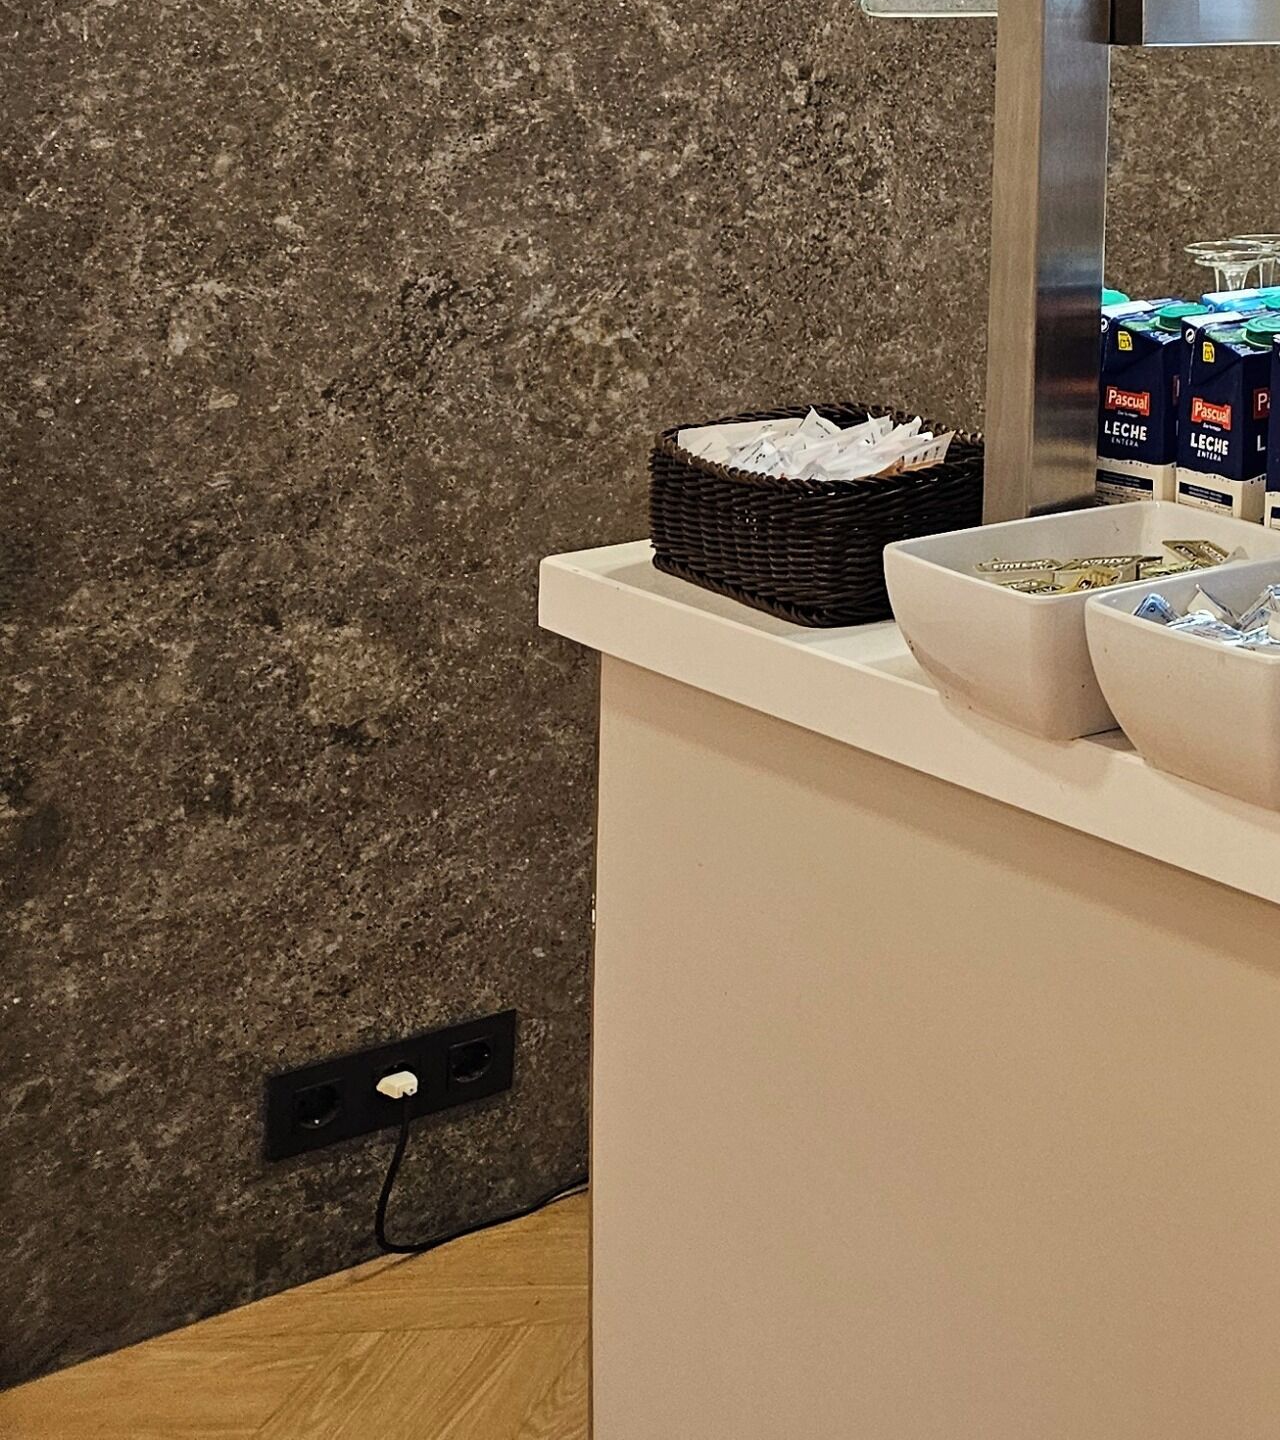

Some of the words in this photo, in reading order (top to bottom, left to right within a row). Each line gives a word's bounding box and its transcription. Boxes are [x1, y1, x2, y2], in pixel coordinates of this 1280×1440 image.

[1108, 389, 1148, 410] Pascual
[1194, 401, 1230, 425] Pascual
[1104, 420, 1148, 442] LECHE
[1111, 437, 1139, 448] ENTERA
[1190, 432, 1230, 456] LECHE
[1197, 449, 1222, 462] ENTERA
